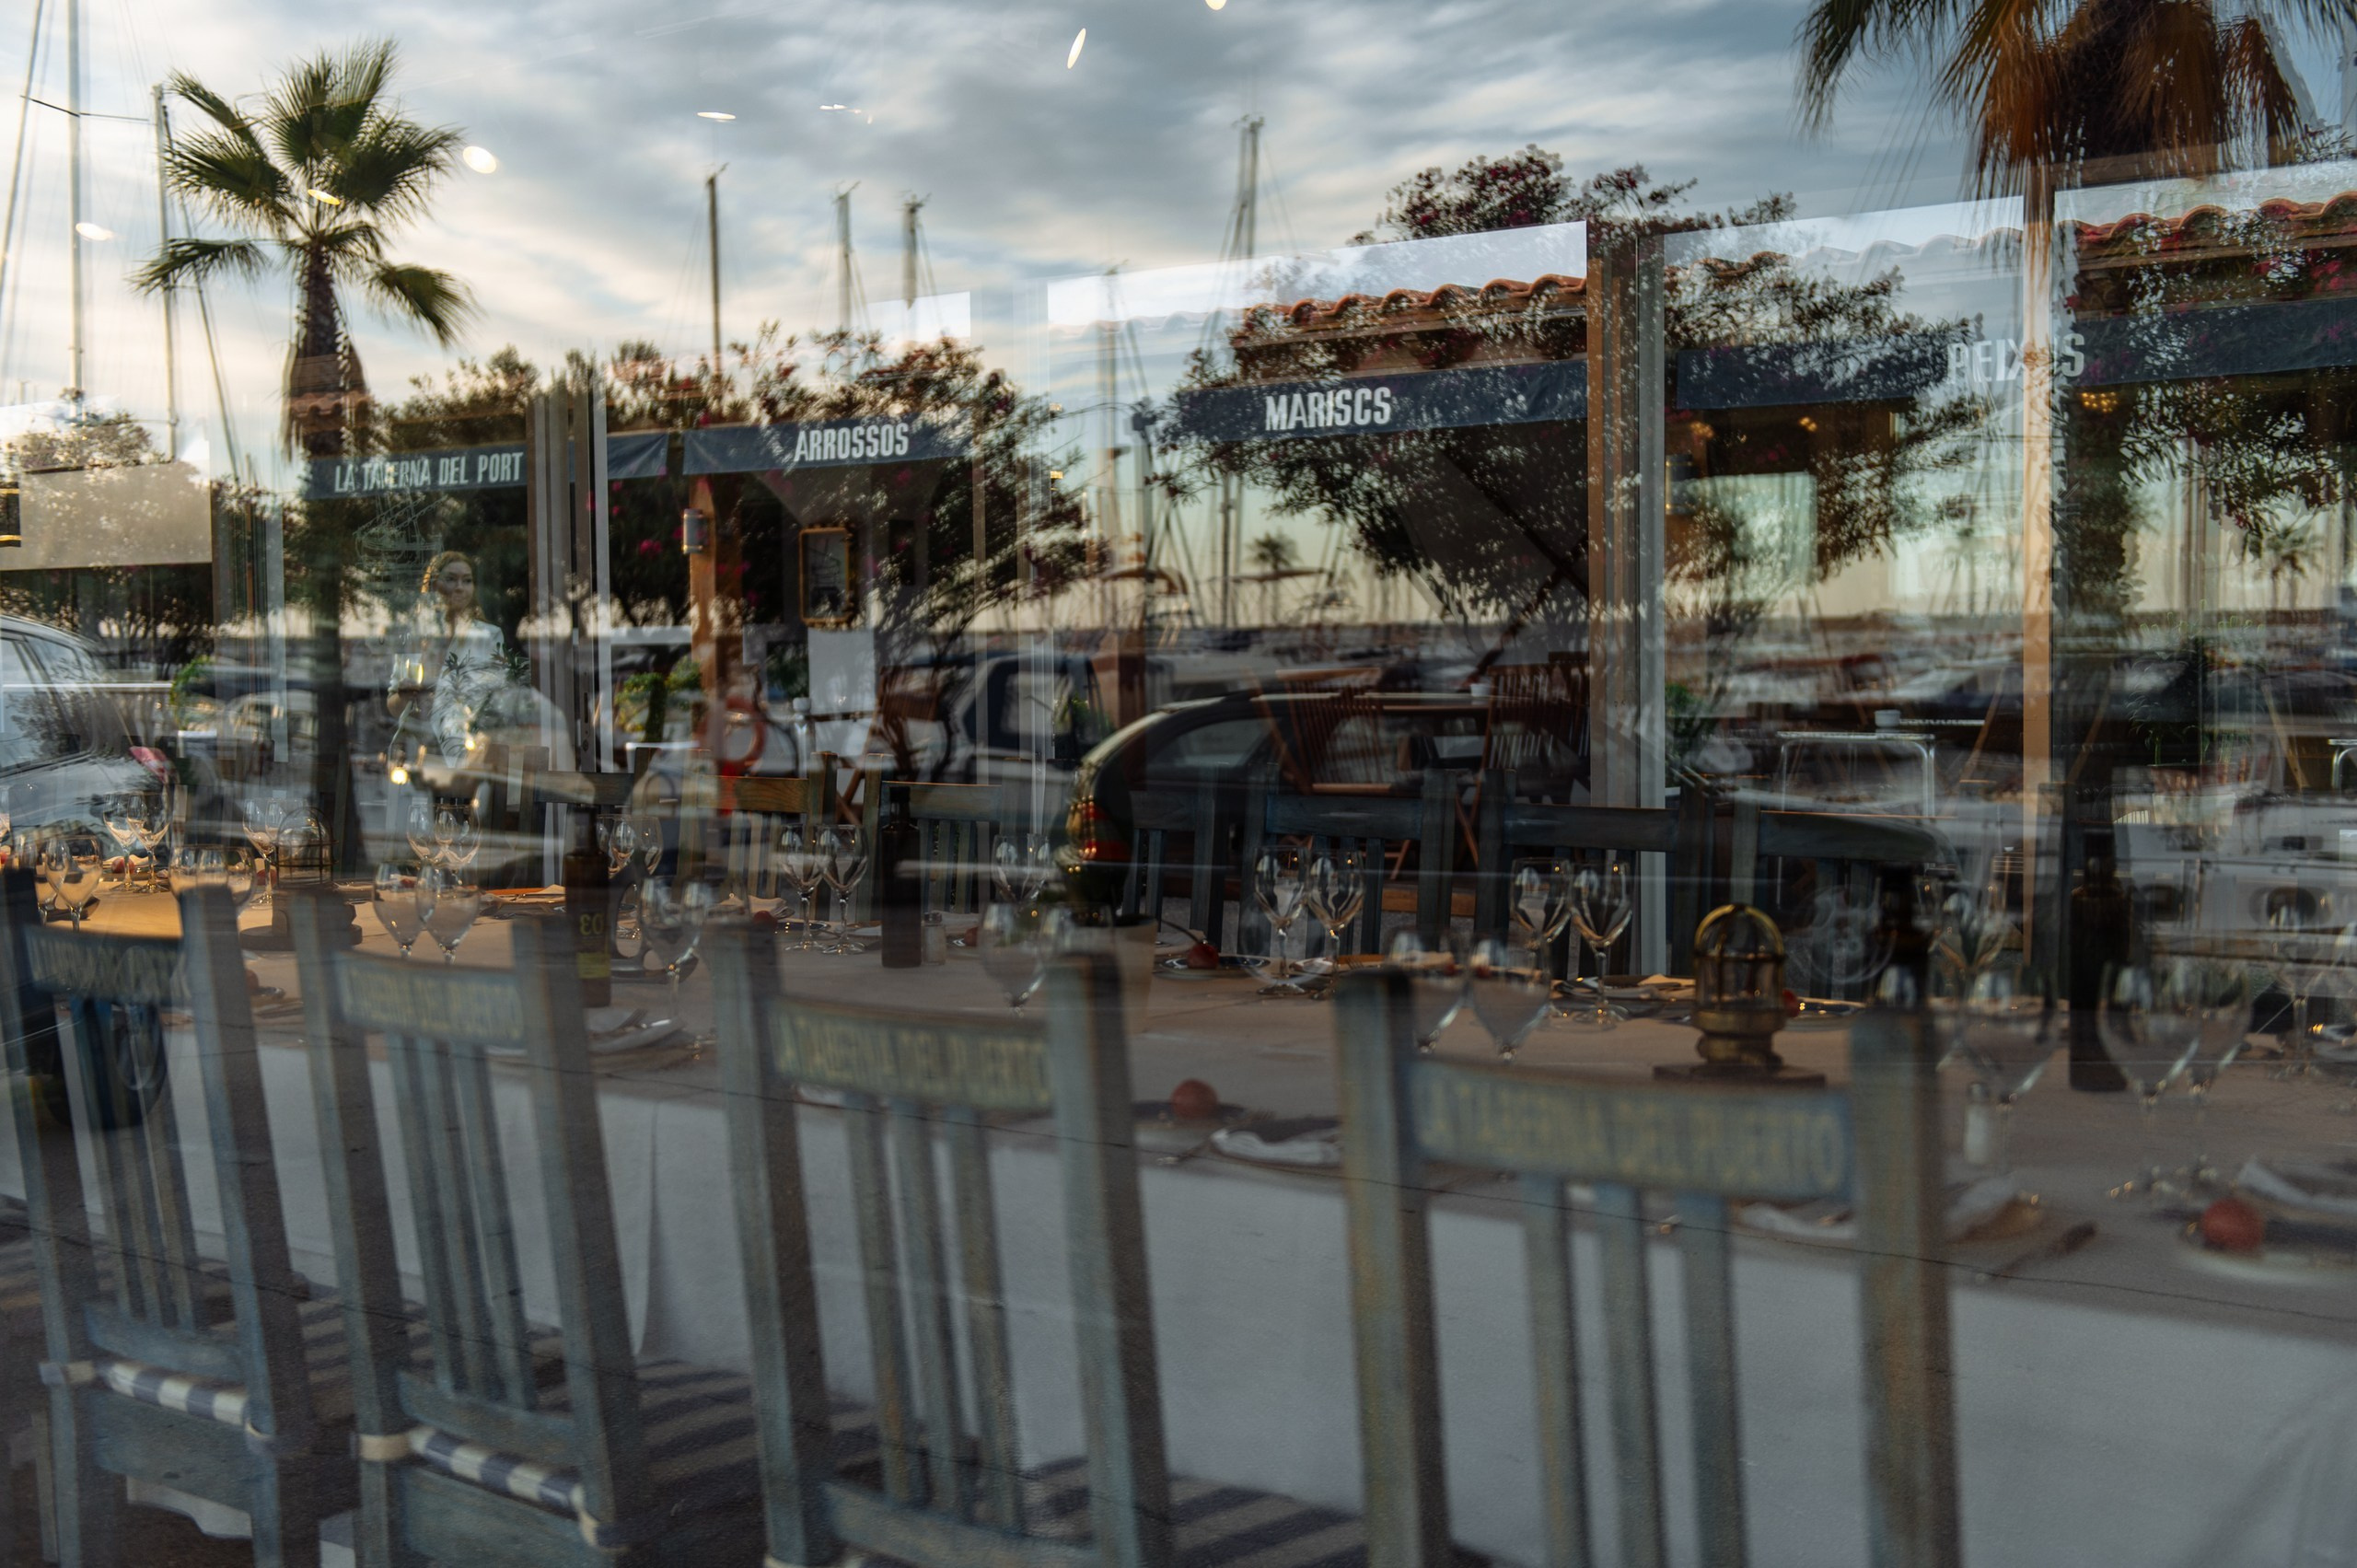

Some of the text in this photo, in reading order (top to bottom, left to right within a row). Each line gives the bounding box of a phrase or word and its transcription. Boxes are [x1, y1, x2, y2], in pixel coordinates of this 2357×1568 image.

[1945, 332, 2085, 385] PEIXS
[1265, 386, 1391, 431] MARISCS
[794, 423, 910, 461] ARROSSOS
[334, 464, 355, 494] LA
[438, 457, 469, 486] DEL
[477, 451, 524, 483] PORT
